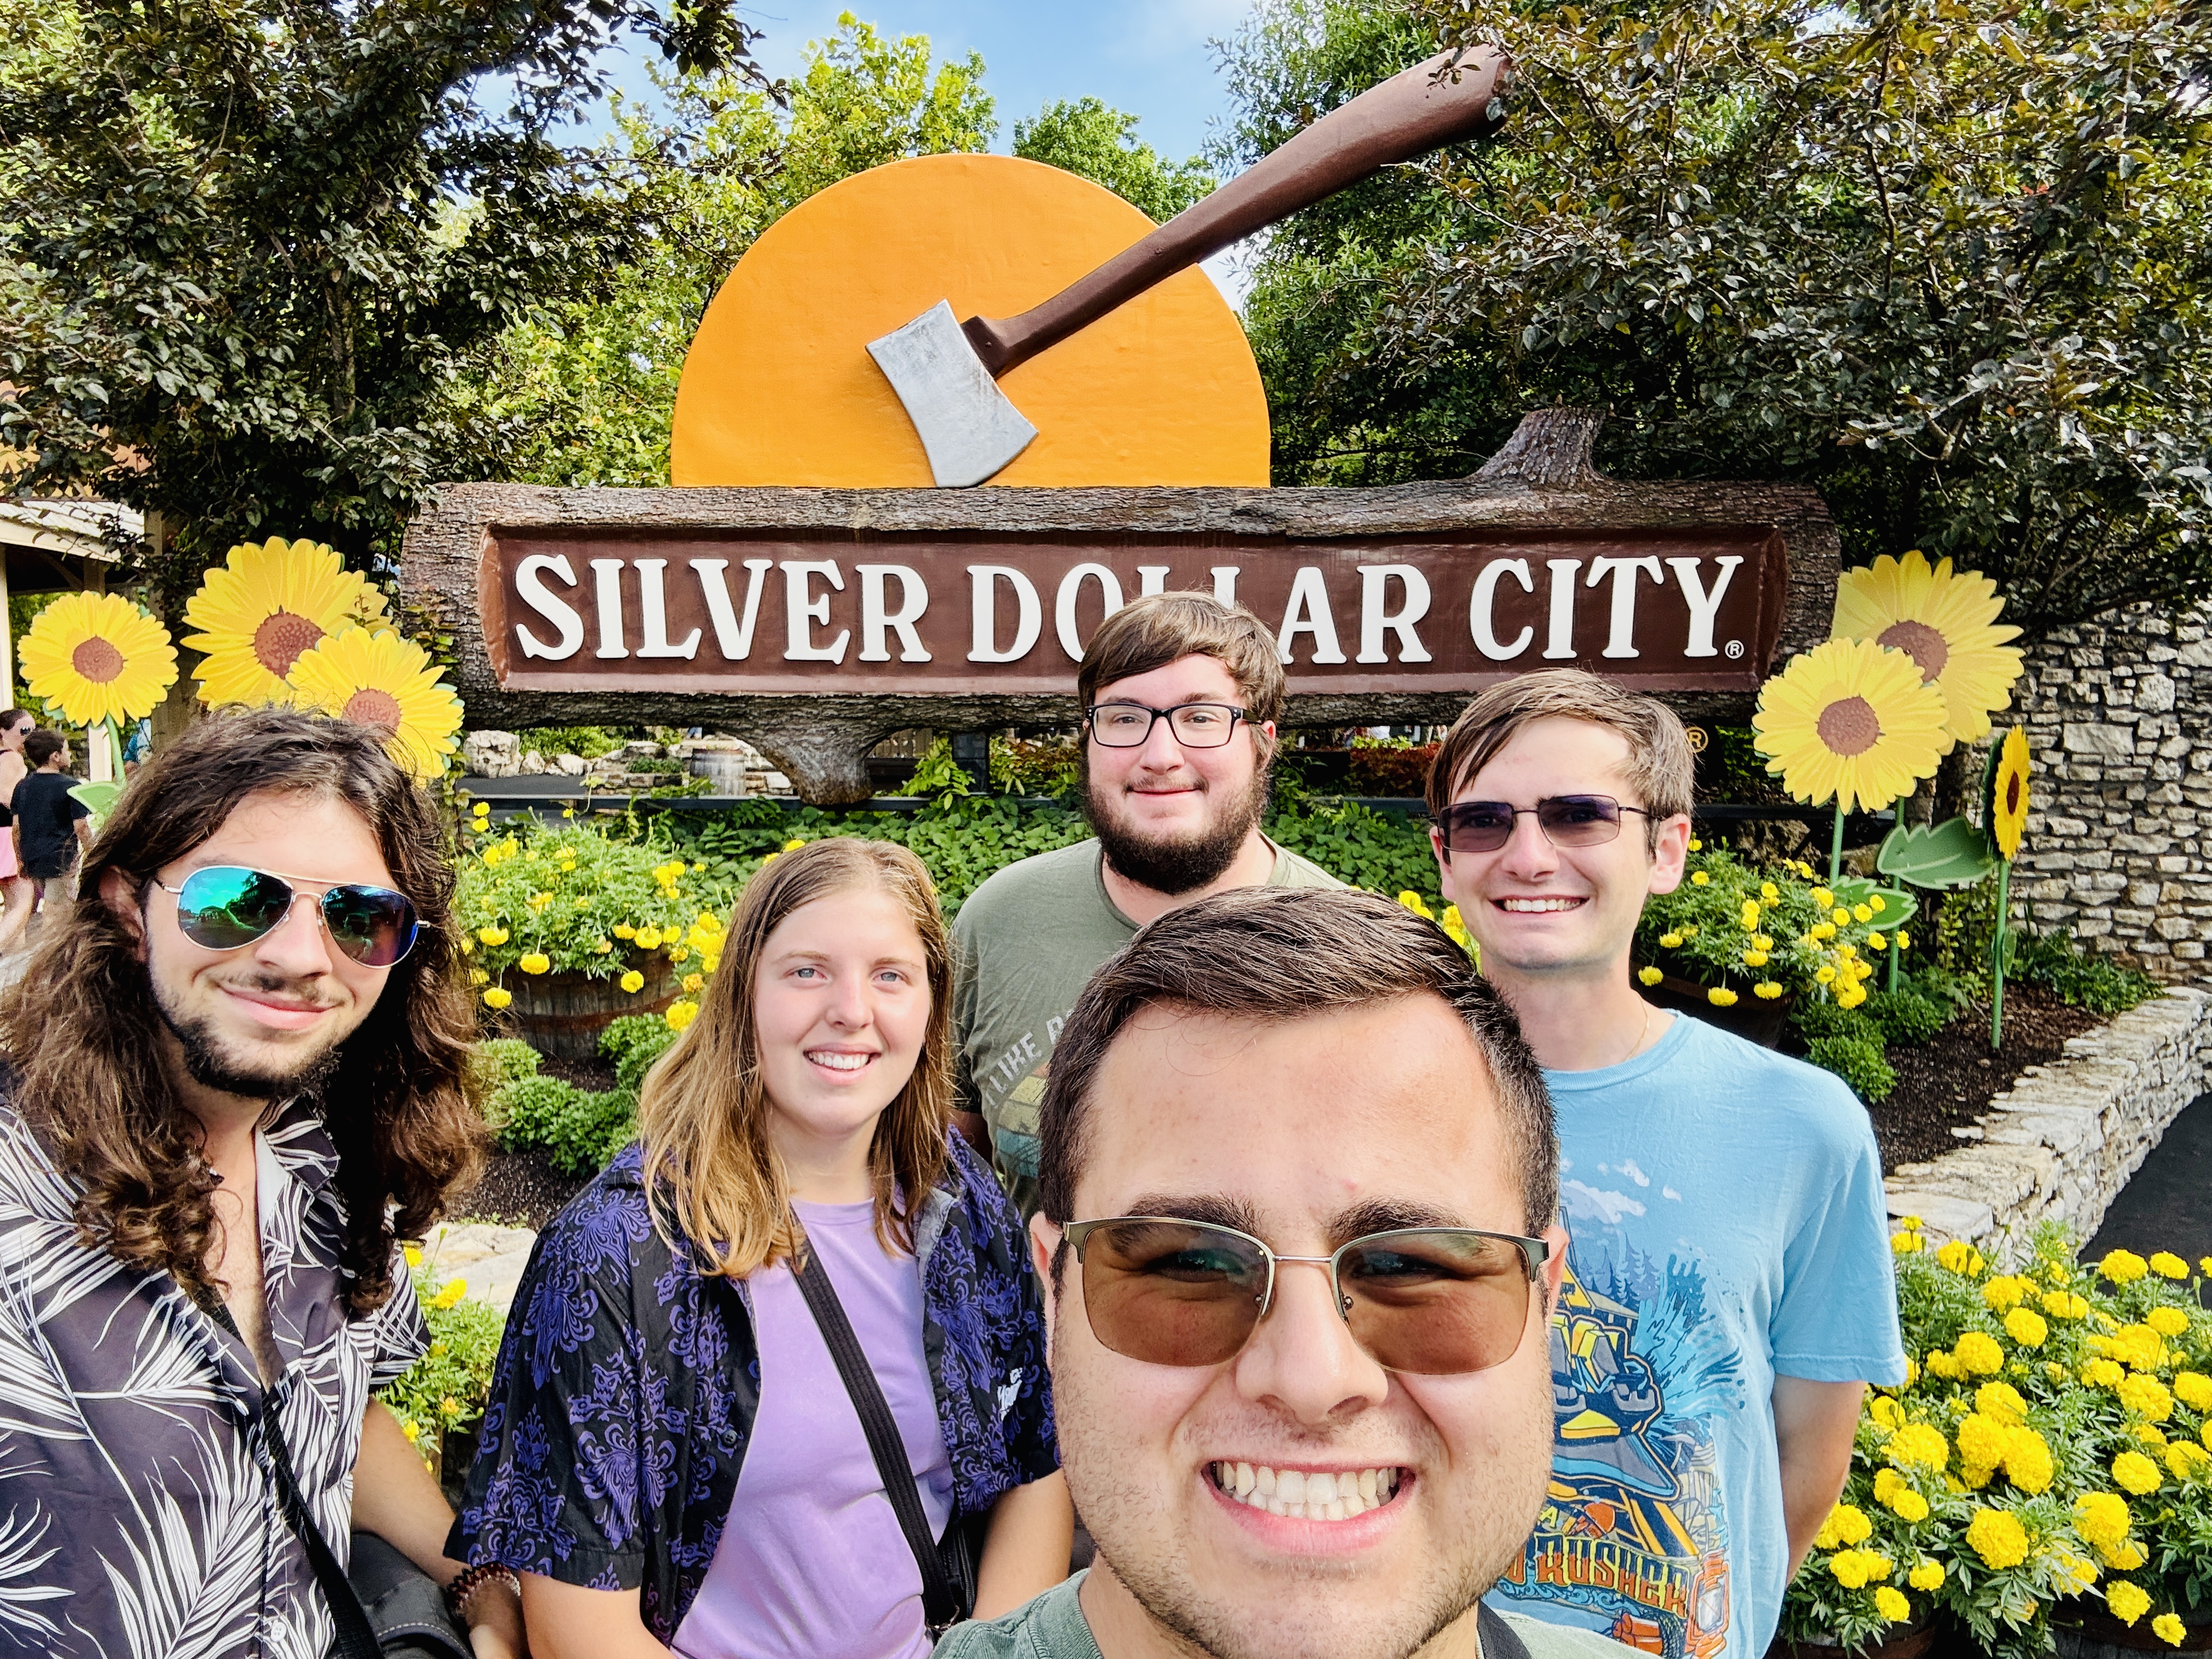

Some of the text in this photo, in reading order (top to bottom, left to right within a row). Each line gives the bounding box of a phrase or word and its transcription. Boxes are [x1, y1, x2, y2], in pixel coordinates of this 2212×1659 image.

[515, 554, 932, 664] SILVER
[967, 563, 1432, 664] DOAR
[989, 1031, 1042, 1094] LIKE
[1536, 1533, 1688, 1618] RUSHER
